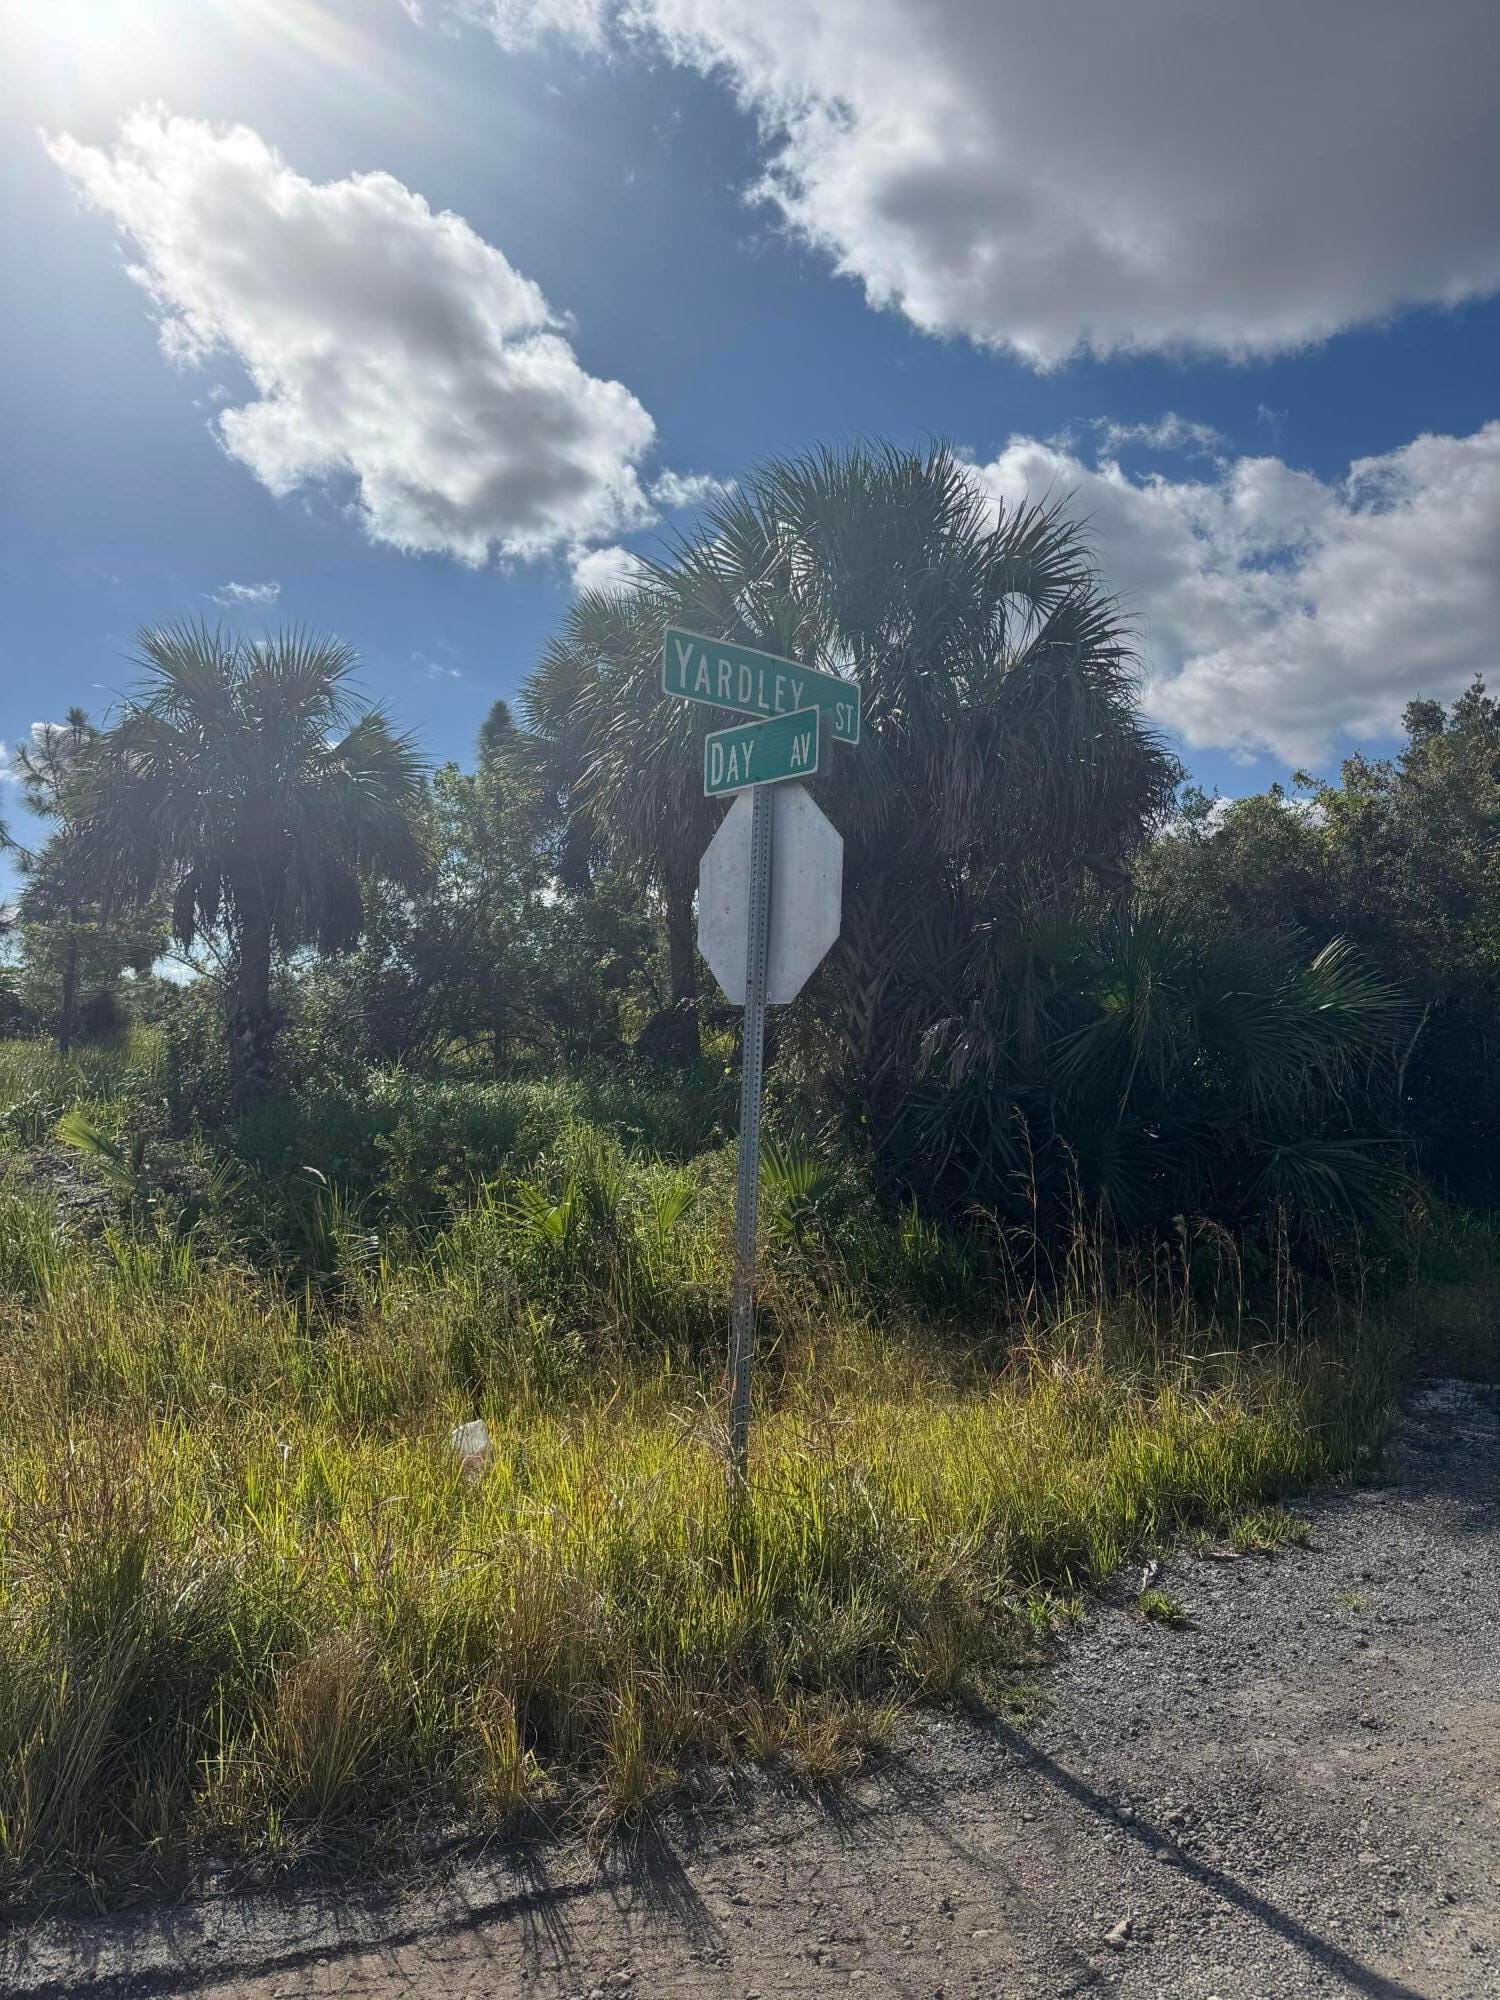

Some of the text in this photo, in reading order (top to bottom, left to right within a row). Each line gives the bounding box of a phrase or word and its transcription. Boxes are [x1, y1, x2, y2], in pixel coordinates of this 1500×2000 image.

[674, 639, 854, 733] YARDLEY ST
[710, 732, 811, 786] DAY AV
